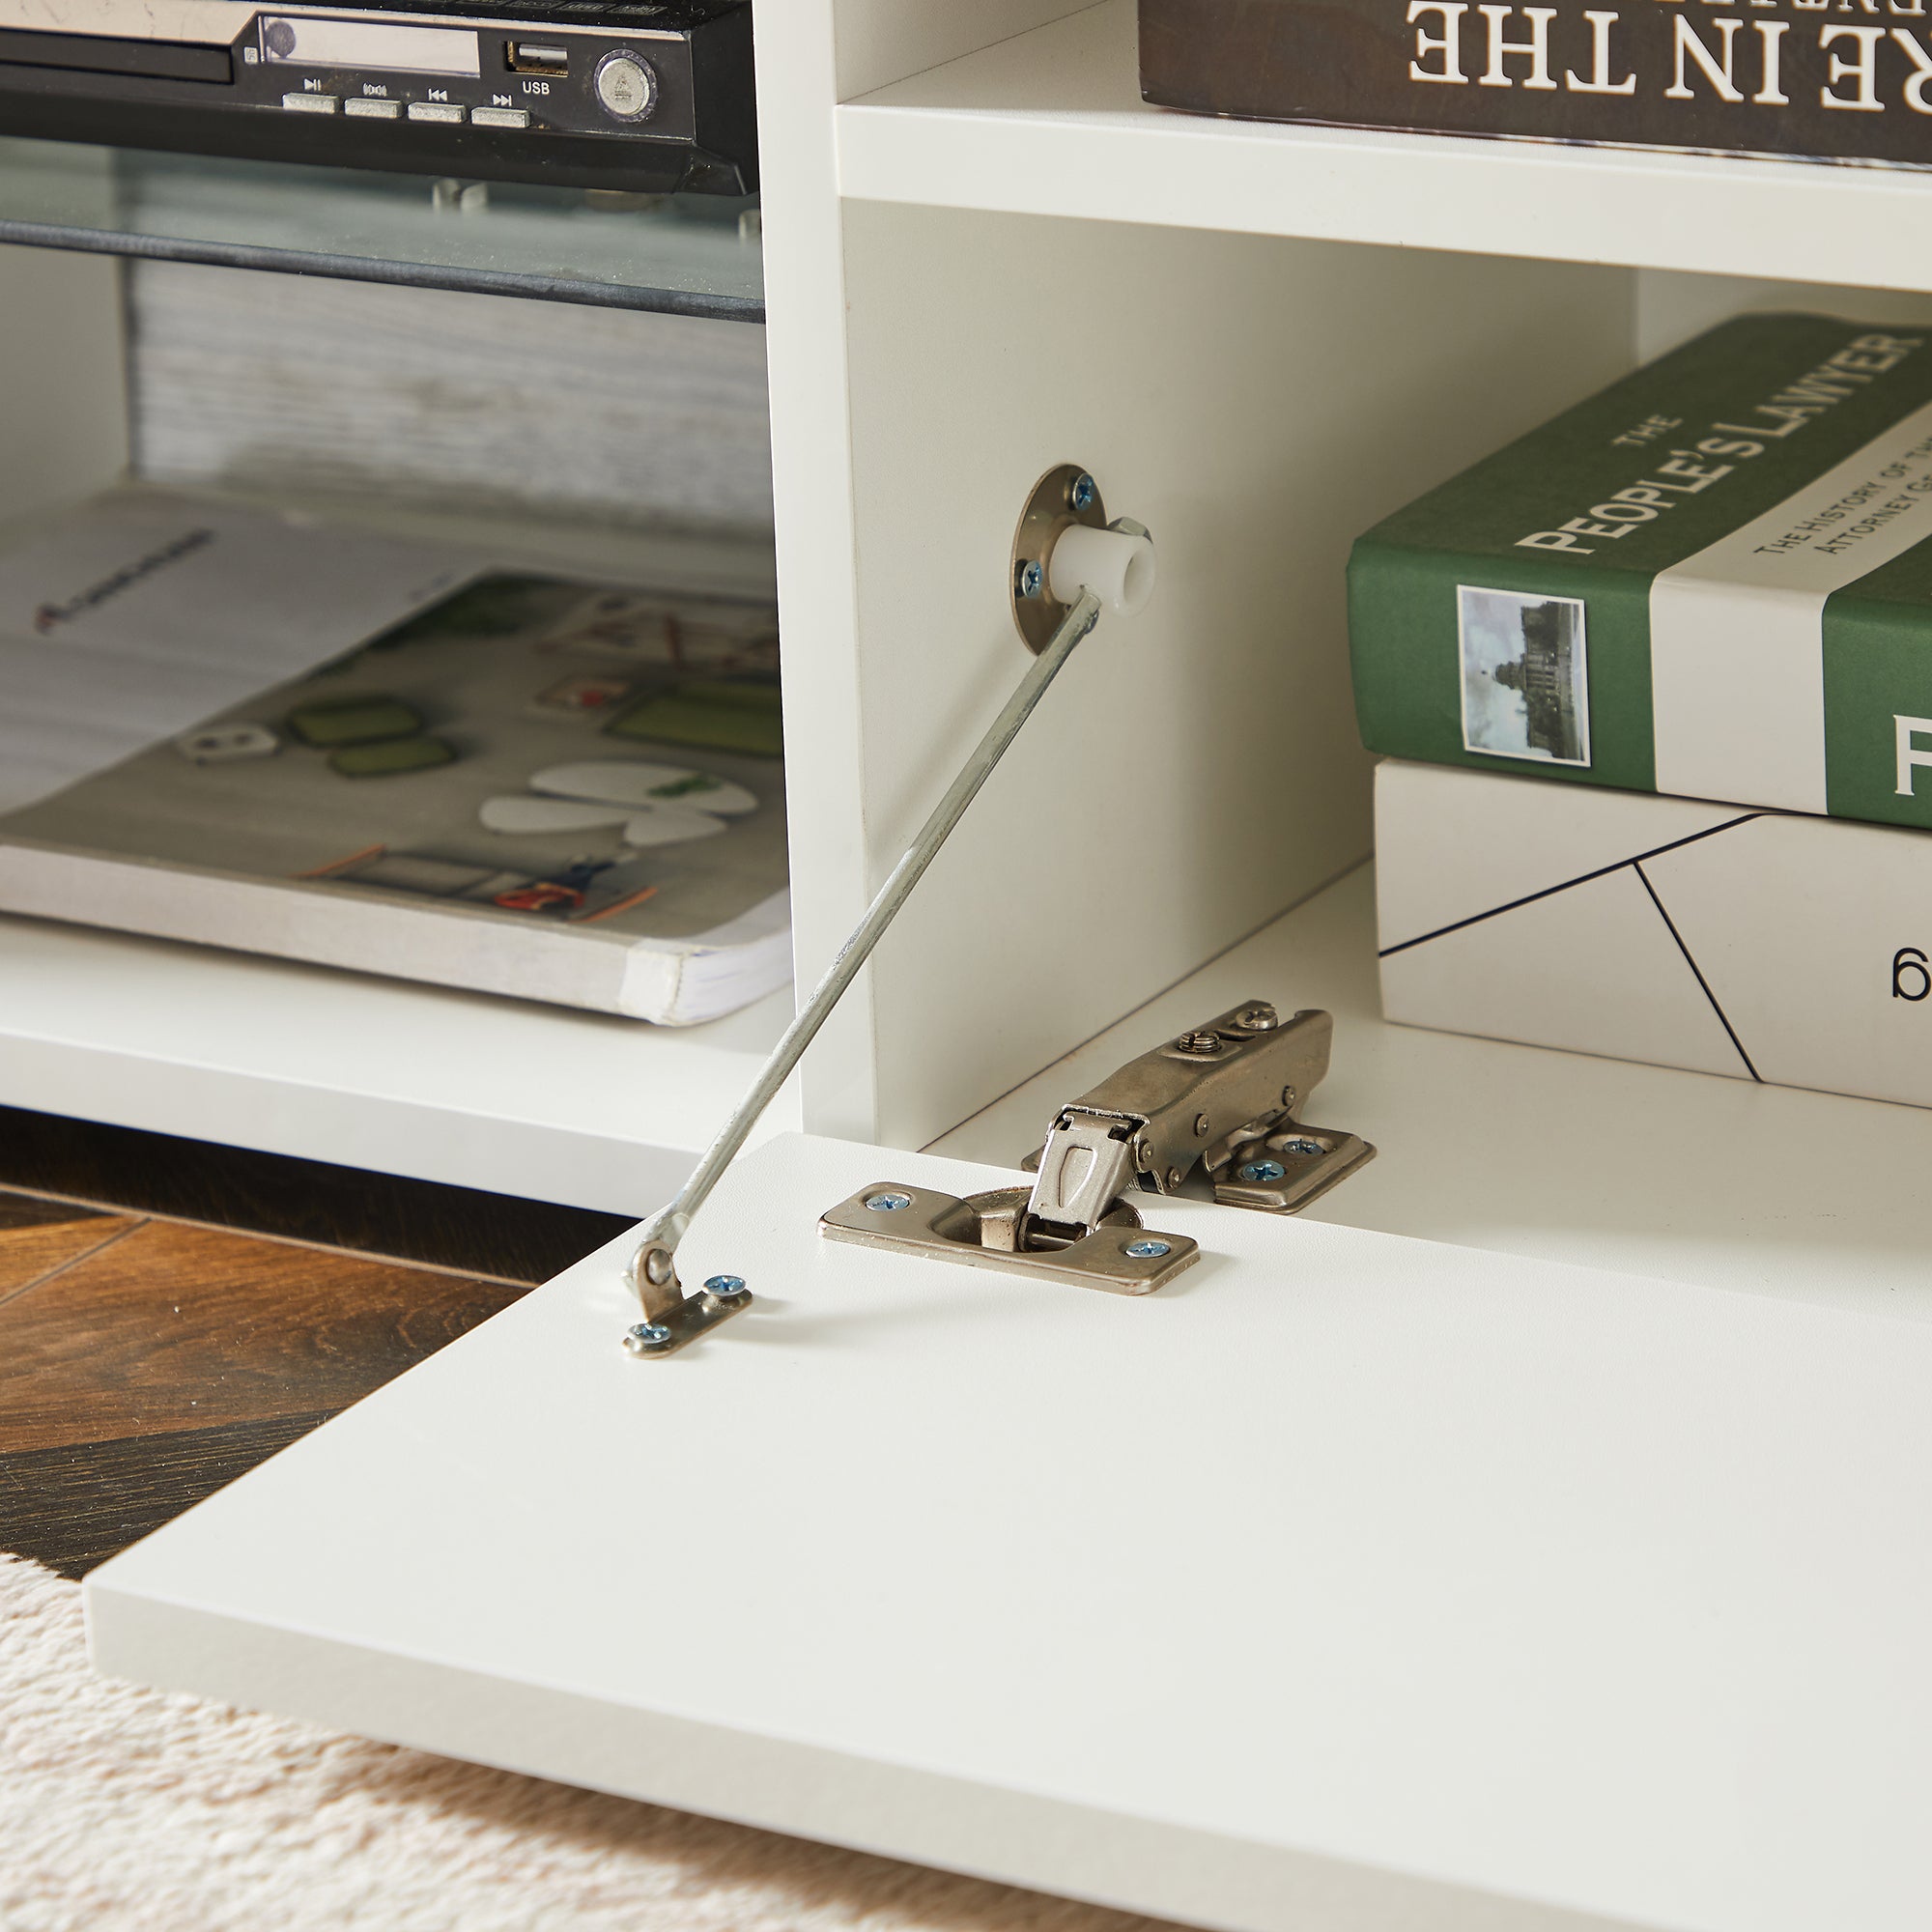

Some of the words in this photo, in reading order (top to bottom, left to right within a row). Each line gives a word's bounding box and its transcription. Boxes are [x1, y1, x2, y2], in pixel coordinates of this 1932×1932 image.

[522, 80, 551, 95] USB
[1406, 0, 1636, 95] THE
[1663, 14, 1790, 105] IN
[1515, 437, 1765, 555] PEOPLE'S
[1710, 333, 1923, 439] LAWYER
[1610, 413, 1683, 447] THE
[1752, 532, 1812, 554] THE
[1794, 481, 1887, 532] HISTORY
[1880, 462, 1912, 479] OF
[1813, 494, 1920, 554] ATTORNEY
